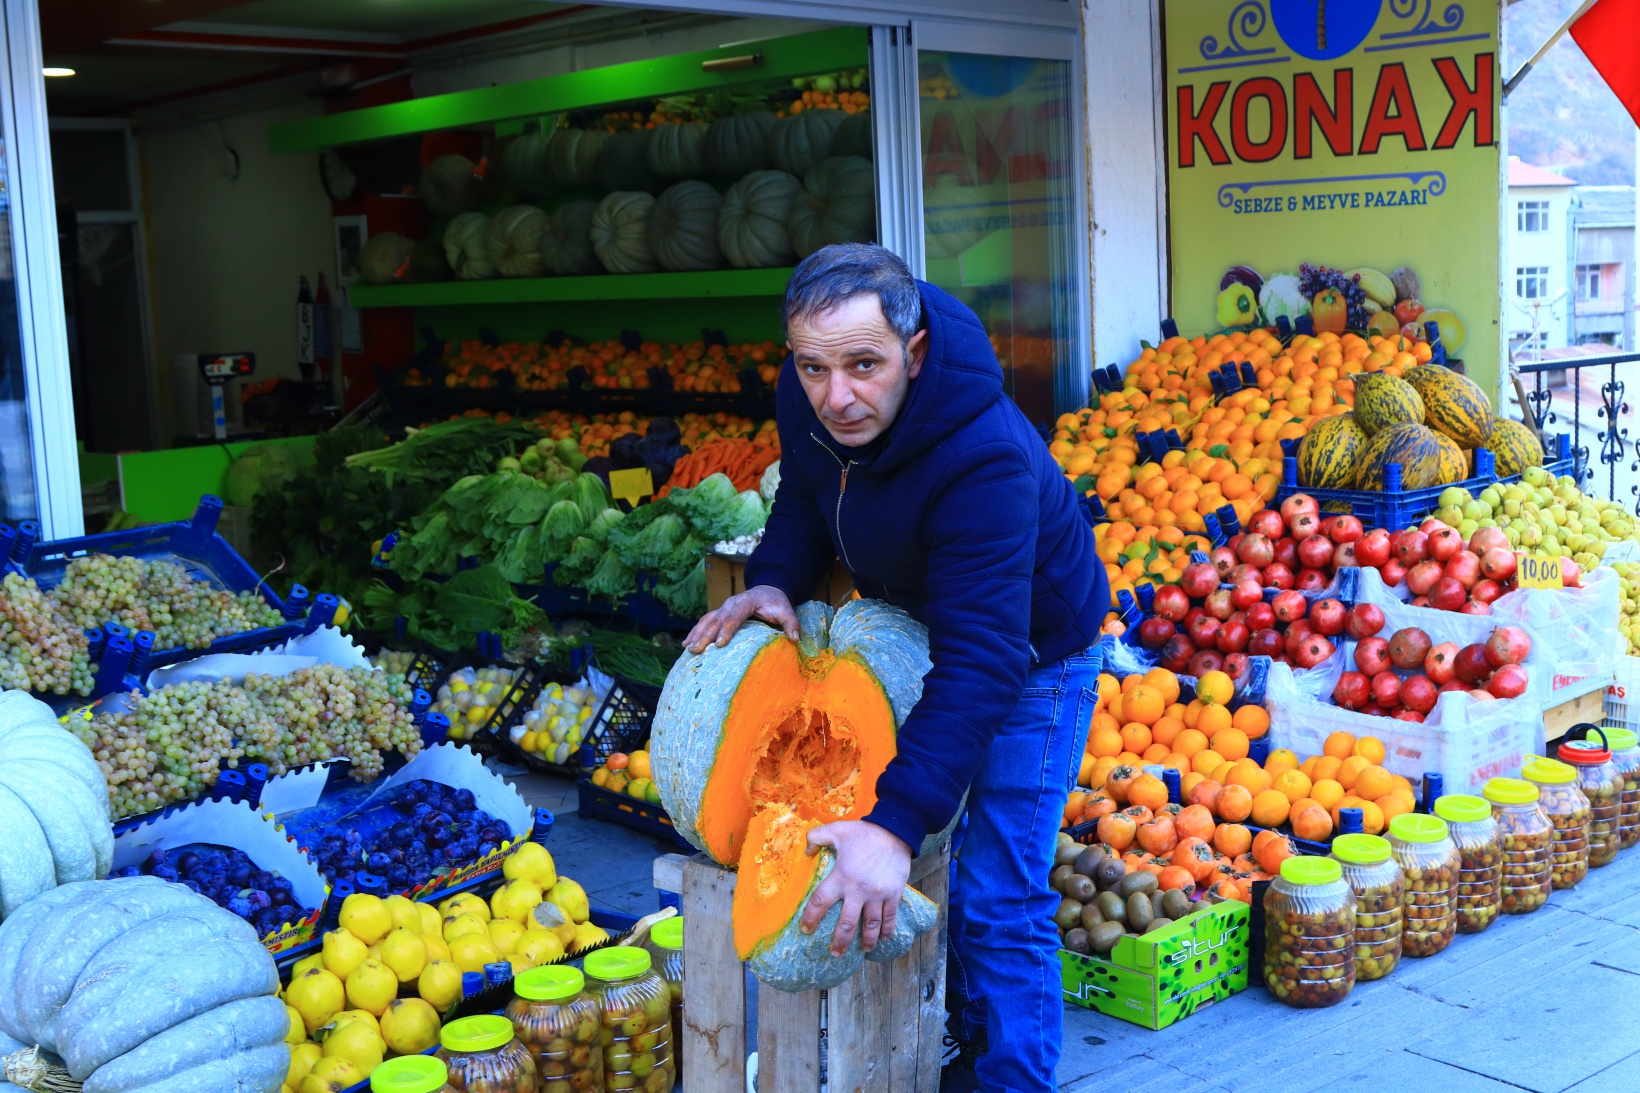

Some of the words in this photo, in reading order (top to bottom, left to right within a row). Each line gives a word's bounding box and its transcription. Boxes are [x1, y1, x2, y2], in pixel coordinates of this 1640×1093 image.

[1177, 52, 1495, 168] KONAK
[1234, 197, 1283, 214] SEBZE
[1287, 196, 1297, 211] &
[1302, 192, 1360, 211] MEYVE
[1364, 189, 1428, 208] PAZARI
[1171, 925, 1240, 967] situr
